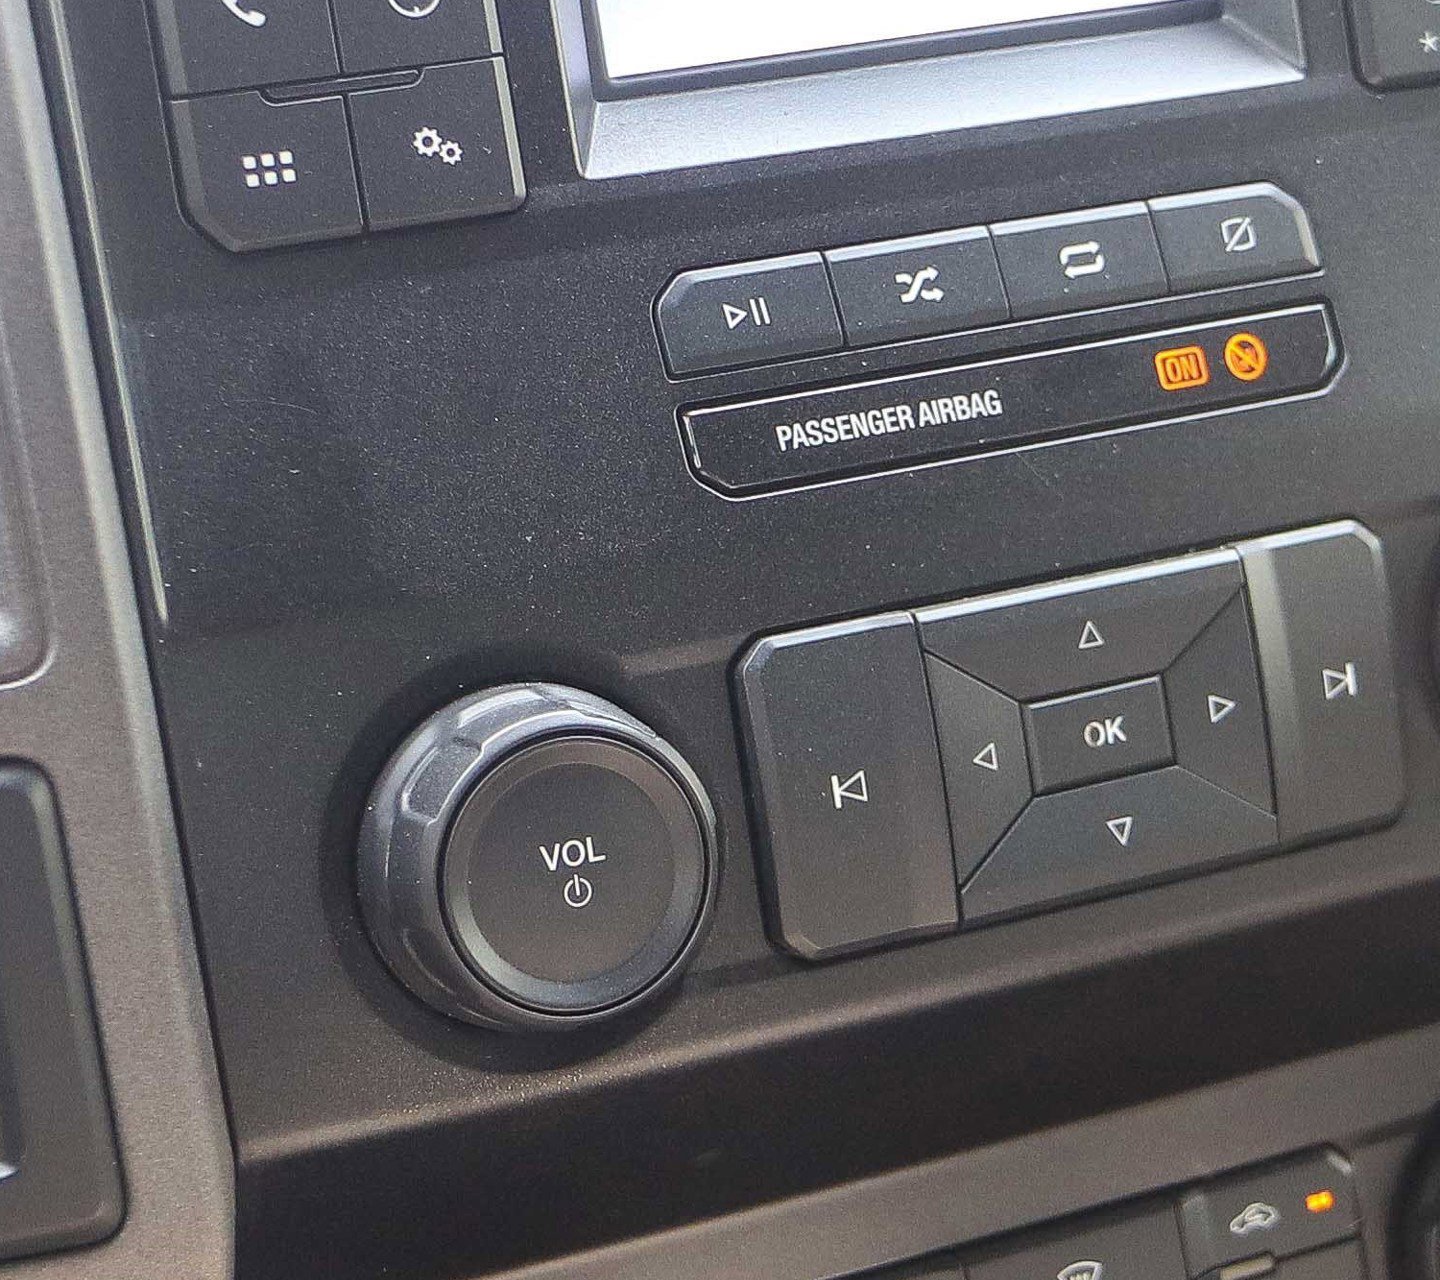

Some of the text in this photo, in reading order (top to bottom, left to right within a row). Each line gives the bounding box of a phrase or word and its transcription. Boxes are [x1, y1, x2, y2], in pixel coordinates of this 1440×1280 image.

[1165, 356, 1201, 383] ON
[773, 390, 1004, 452] PASSENGER AIRBAG
[1085, 717, 1128, 748] OK
[540, 837, 607, 872] VOL
